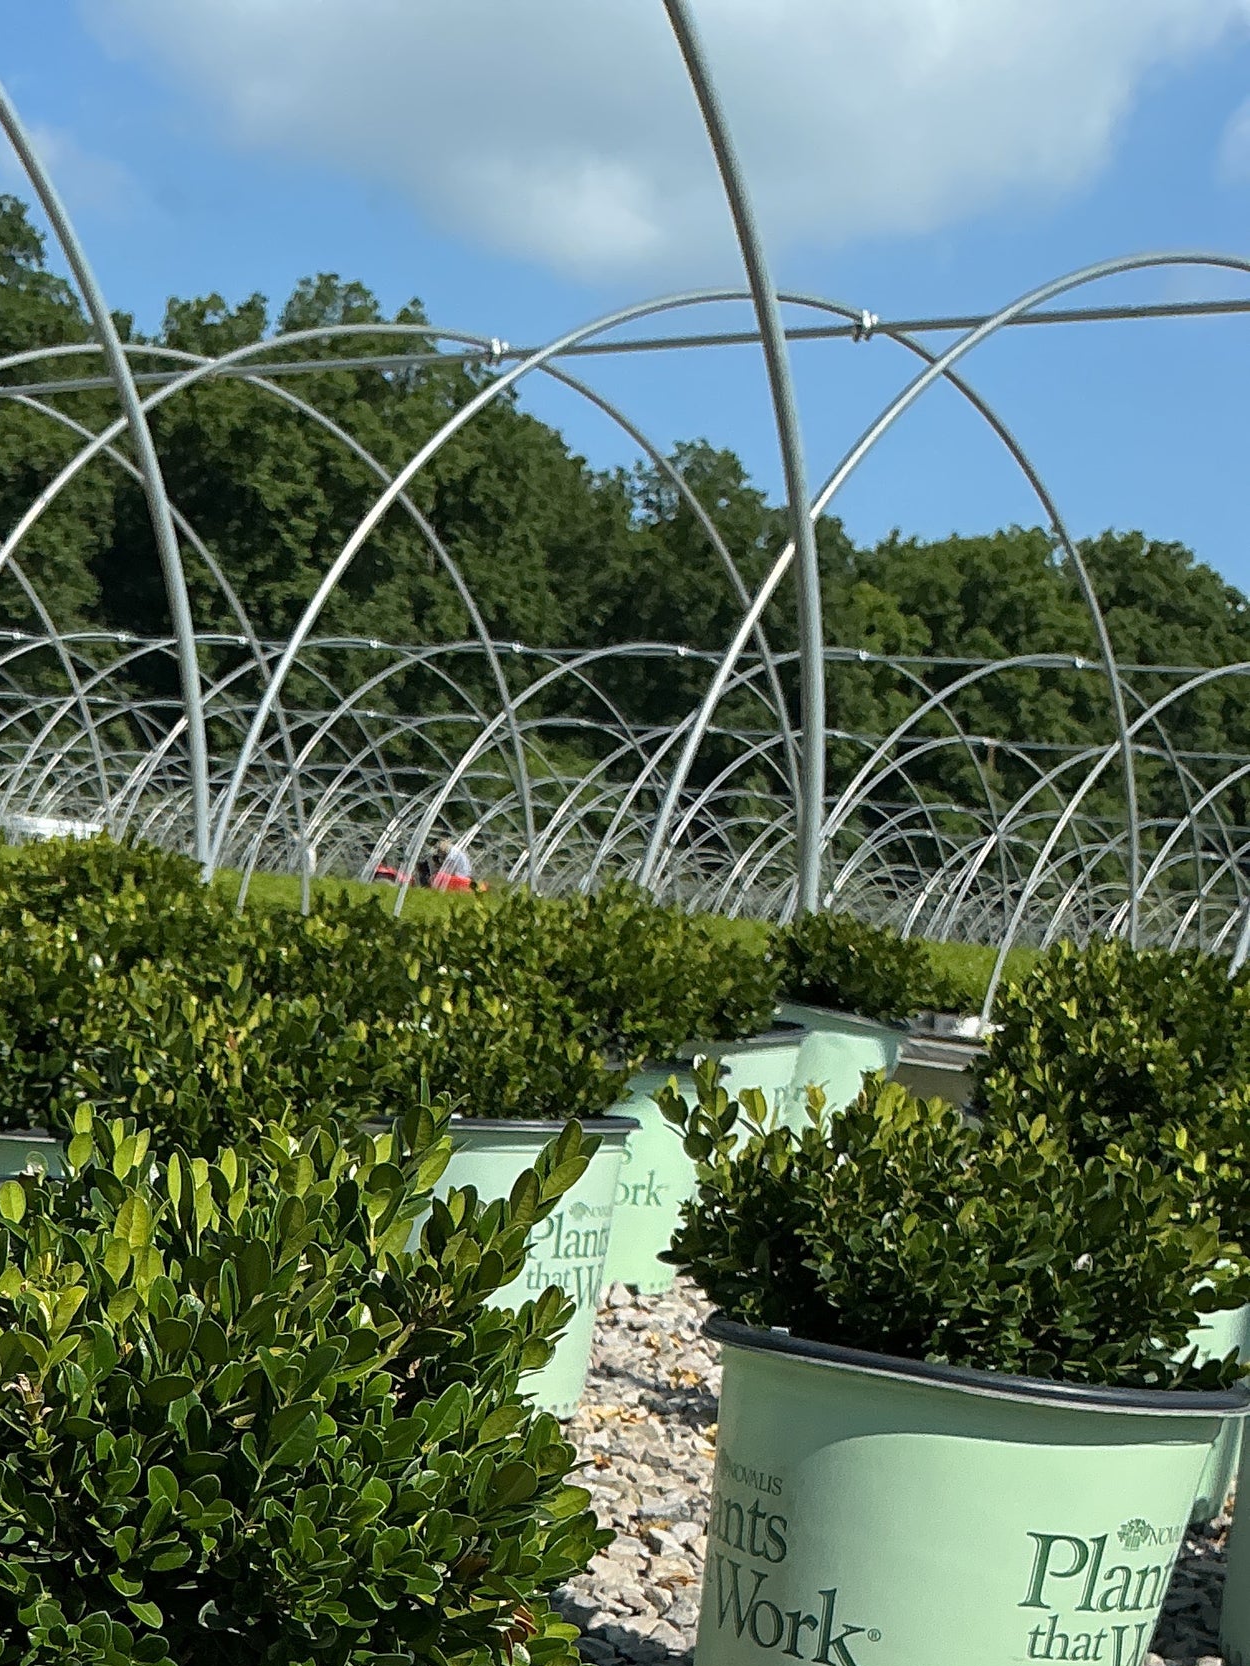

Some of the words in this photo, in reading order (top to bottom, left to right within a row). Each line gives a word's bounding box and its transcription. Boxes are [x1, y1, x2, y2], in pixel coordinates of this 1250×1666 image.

[615, 1169, 668, 1207] ork
[712, 1491, 787, 1563] ants
[1016, 1531, 1173, 1613] Plant
[1027, 1613, 1108, 1661] that
